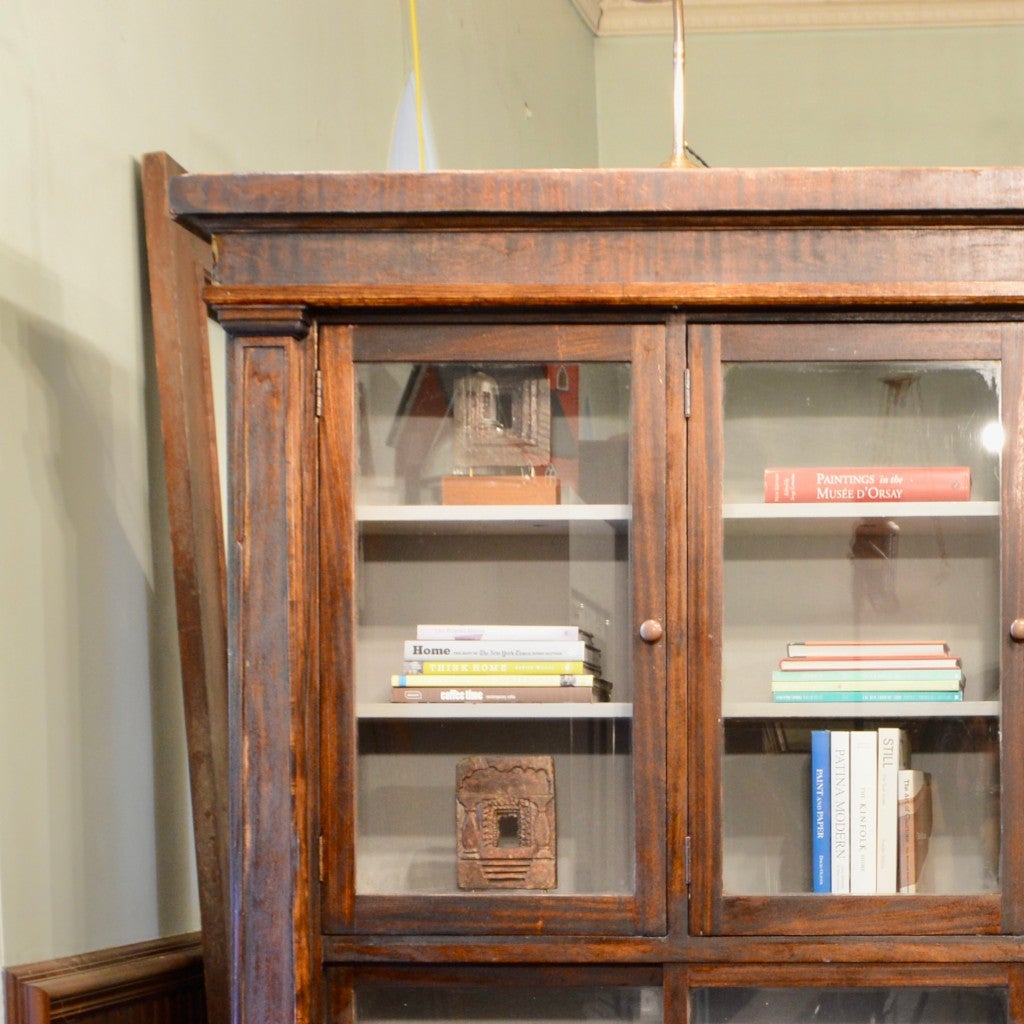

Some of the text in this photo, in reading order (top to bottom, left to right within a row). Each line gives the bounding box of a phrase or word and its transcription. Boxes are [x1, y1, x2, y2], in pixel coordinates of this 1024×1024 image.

[816, 472, 904, 485] PAINTINGS in the
[816, 486, 854, 499] MUSÉE
[412, 645, 451, 656] Home
[429, 663, 470, 672] THINK
[473, 663, 508, 672] HOME
[465, 690, 484, 701] time
[882, 737, 894, 768] STILL
[815, 768, 824, 796] PAINT
[835, 748, 845, 796] PATINA
[816, 811, 825, 839] PAPER
[836, 800, 847, 860] MODERN
[859, 803, 867, 851] KINFOLK
